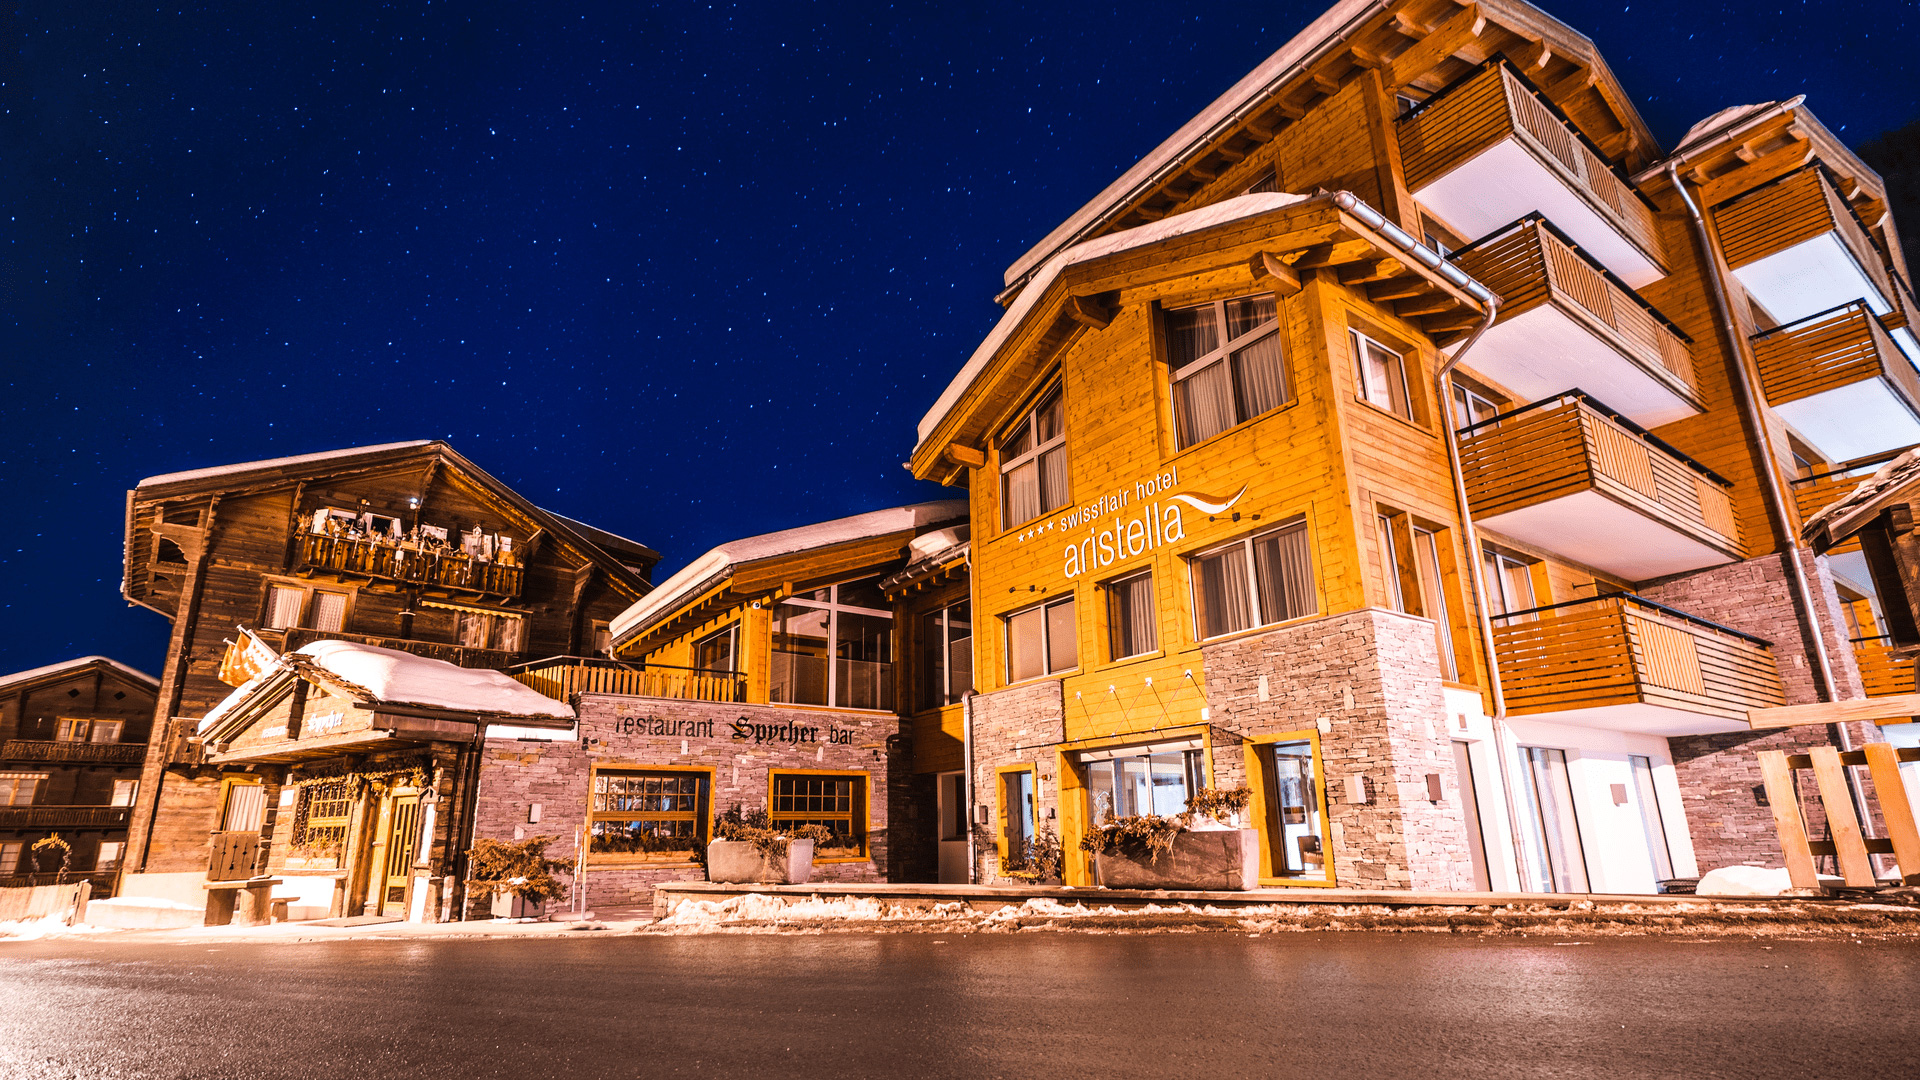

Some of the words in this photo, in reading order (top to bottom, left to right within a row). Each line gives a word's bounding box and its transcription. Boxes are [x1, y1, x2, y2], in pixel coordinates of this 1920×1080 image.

[1061, 489, 1130, 532] swissflair
[1136, 465, 1179, 501] hotel
[1064, 502, 1186, 578] aristella
[615, 714, 715, 739] restaurant
[727, 716, 819, 746] Spycher
[829, 724, 855, 745] bar
